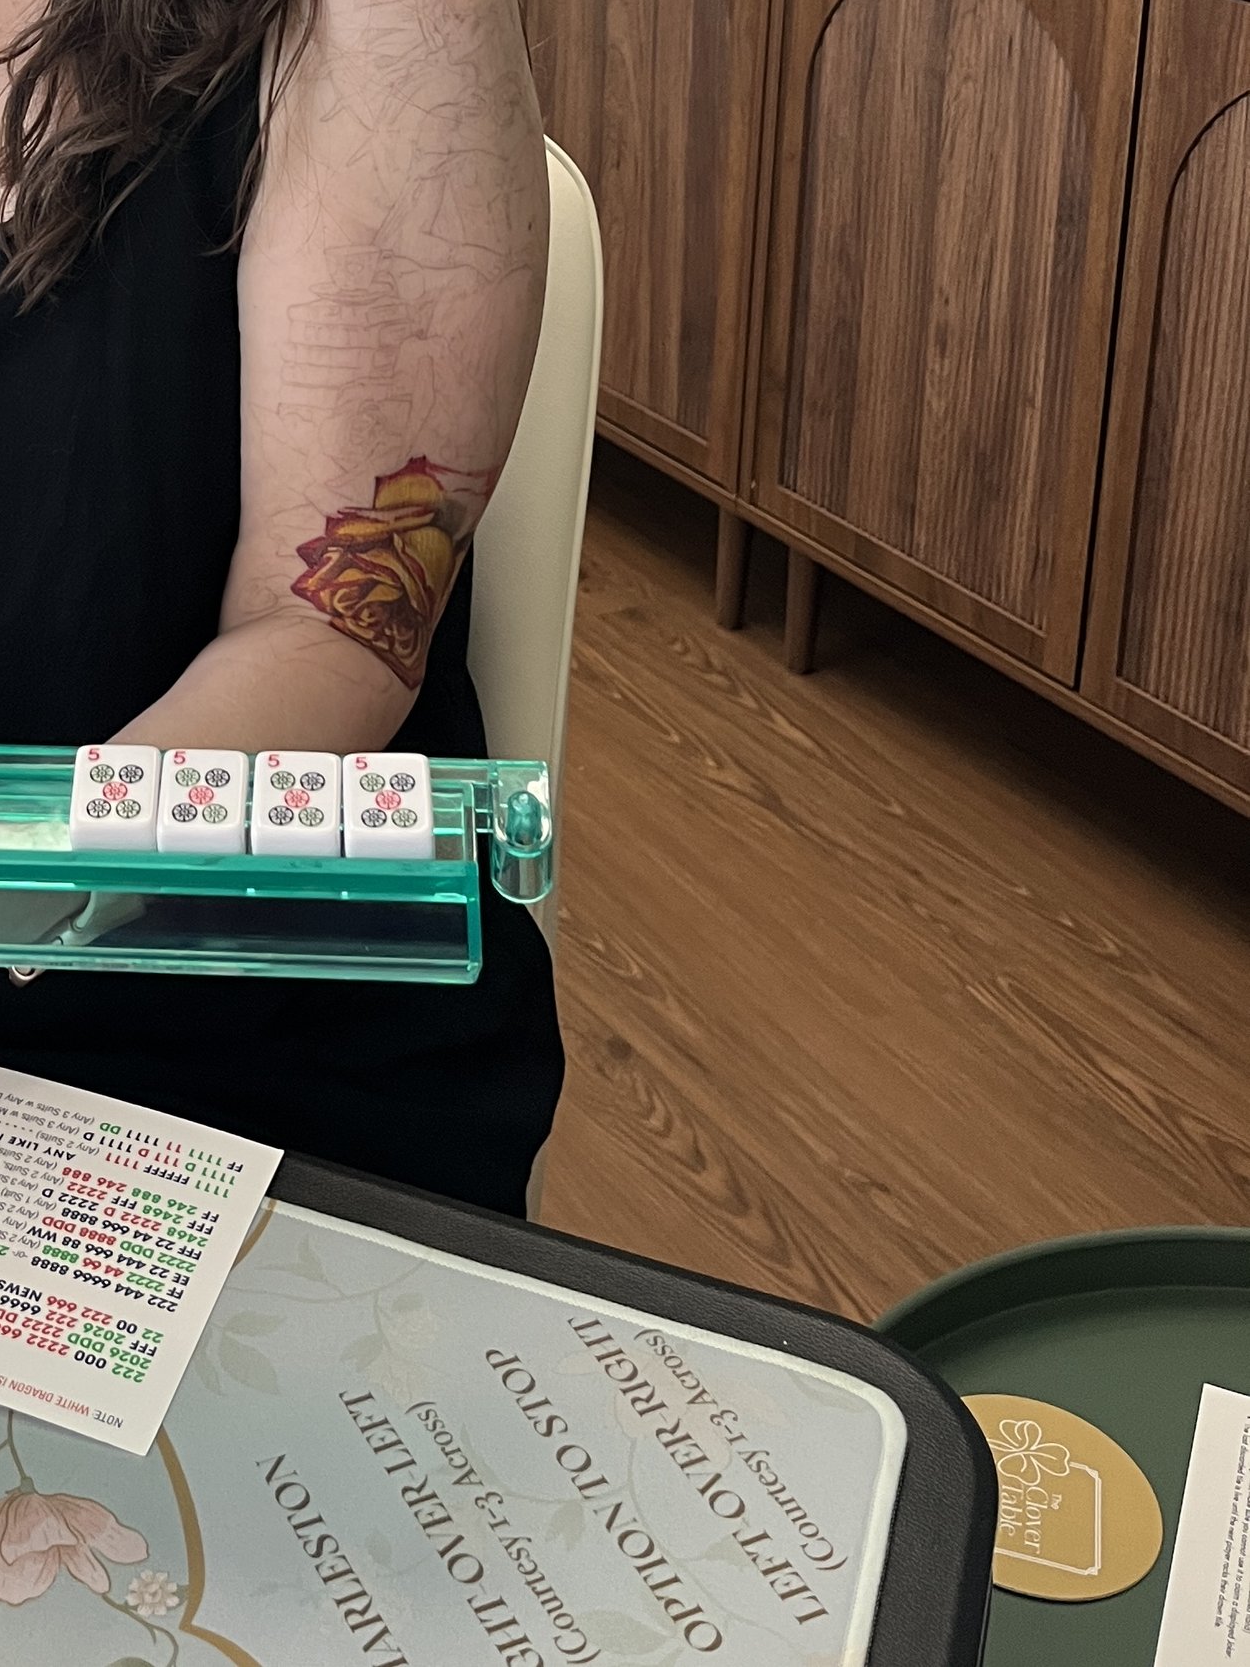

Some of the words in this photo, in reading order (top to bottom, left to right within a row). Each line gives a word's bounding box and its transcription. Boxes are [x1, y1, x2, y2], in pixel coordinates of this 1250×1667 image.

[88, 748, 100, 761] 5
[173, 751, 186, 765] 5
[267, 754, 280, 768] 5
[355, 757, 368, 770] 5
[6, 1135, 39, 1151] LIKE
[41, 1145, 76, 1161] ANY
[20, 1315, 64, 1338] 2222
[25, 1332, 70, 1356] 2222
[66, 1332, 105, 1353] DDD
[73, 1349, 107, 1369] 000
[109, 1346, 152, 1370] 2026
[633, 1328, 719, 1407] Across)
[111, 1361, 145, 1383] 222
[8, 1379, 54, 1403] DRAGON
[485, 1348, 569, 1438] STOP
[55, 1395, 89, 1416] WHITE
[710, 1409, 748, 1446] 1-3
[404, 1401, 485, 1487] Across)
[556, 1444, 610, 1500] TO
[474, 1491, 511, 1532] 1-3
[737, 1449, 848, 1571] (Courtesy
[1000, 1483, 1024, 1537] Table
[1024, 1485, 1049, 1555] Clover
[593, 1501, 723, 1653] OPTION
[499, 1535, 601, 1665] (Courtesy
